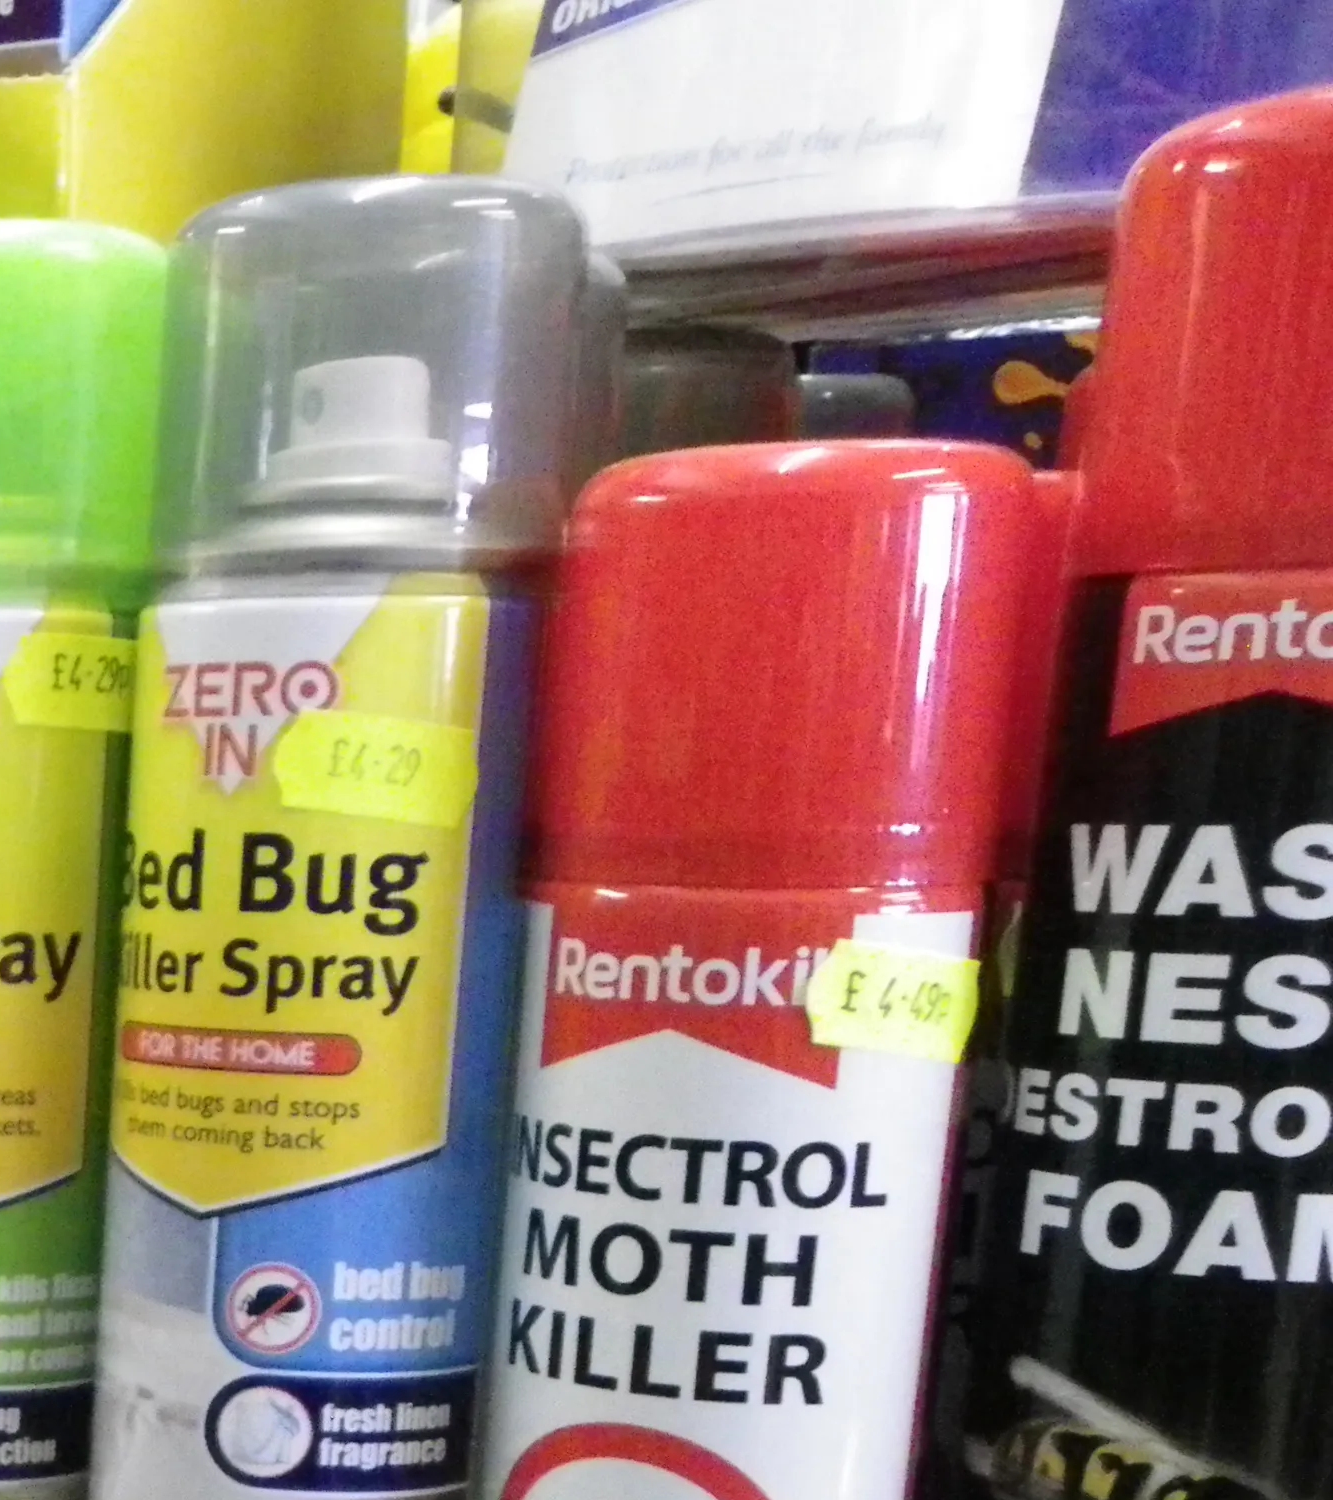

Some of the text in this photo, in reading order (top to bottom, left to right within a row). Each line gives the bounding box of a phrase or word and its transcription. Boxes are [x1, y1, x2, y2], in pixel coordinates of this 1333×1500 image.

[163, 659, 340, 719] ZERO
[203, 723, 258, 777] IN
[238, 831, 430, 936] Bug
[218, 937, 420, 1017] Spray
[1057, 946, 1333, 1051] NES
[137, 1029, 317, 1068] FOR THE HOME
[139, 1085, 362, 1125] bed bugs and stops
[171, 1119, 255, 1154] coming
[263, 1126, 326, 1151] back
[332, 1260, 406, 1302] bed
[522, 1206, 821, 1308] MOTH
[328, 1309, 457, 1353] control
[507, 1296, 828, 1406] KILLER
[319, 1401, 394, 1435] fresh
[317, 1437, 448, 1472] fragrance
